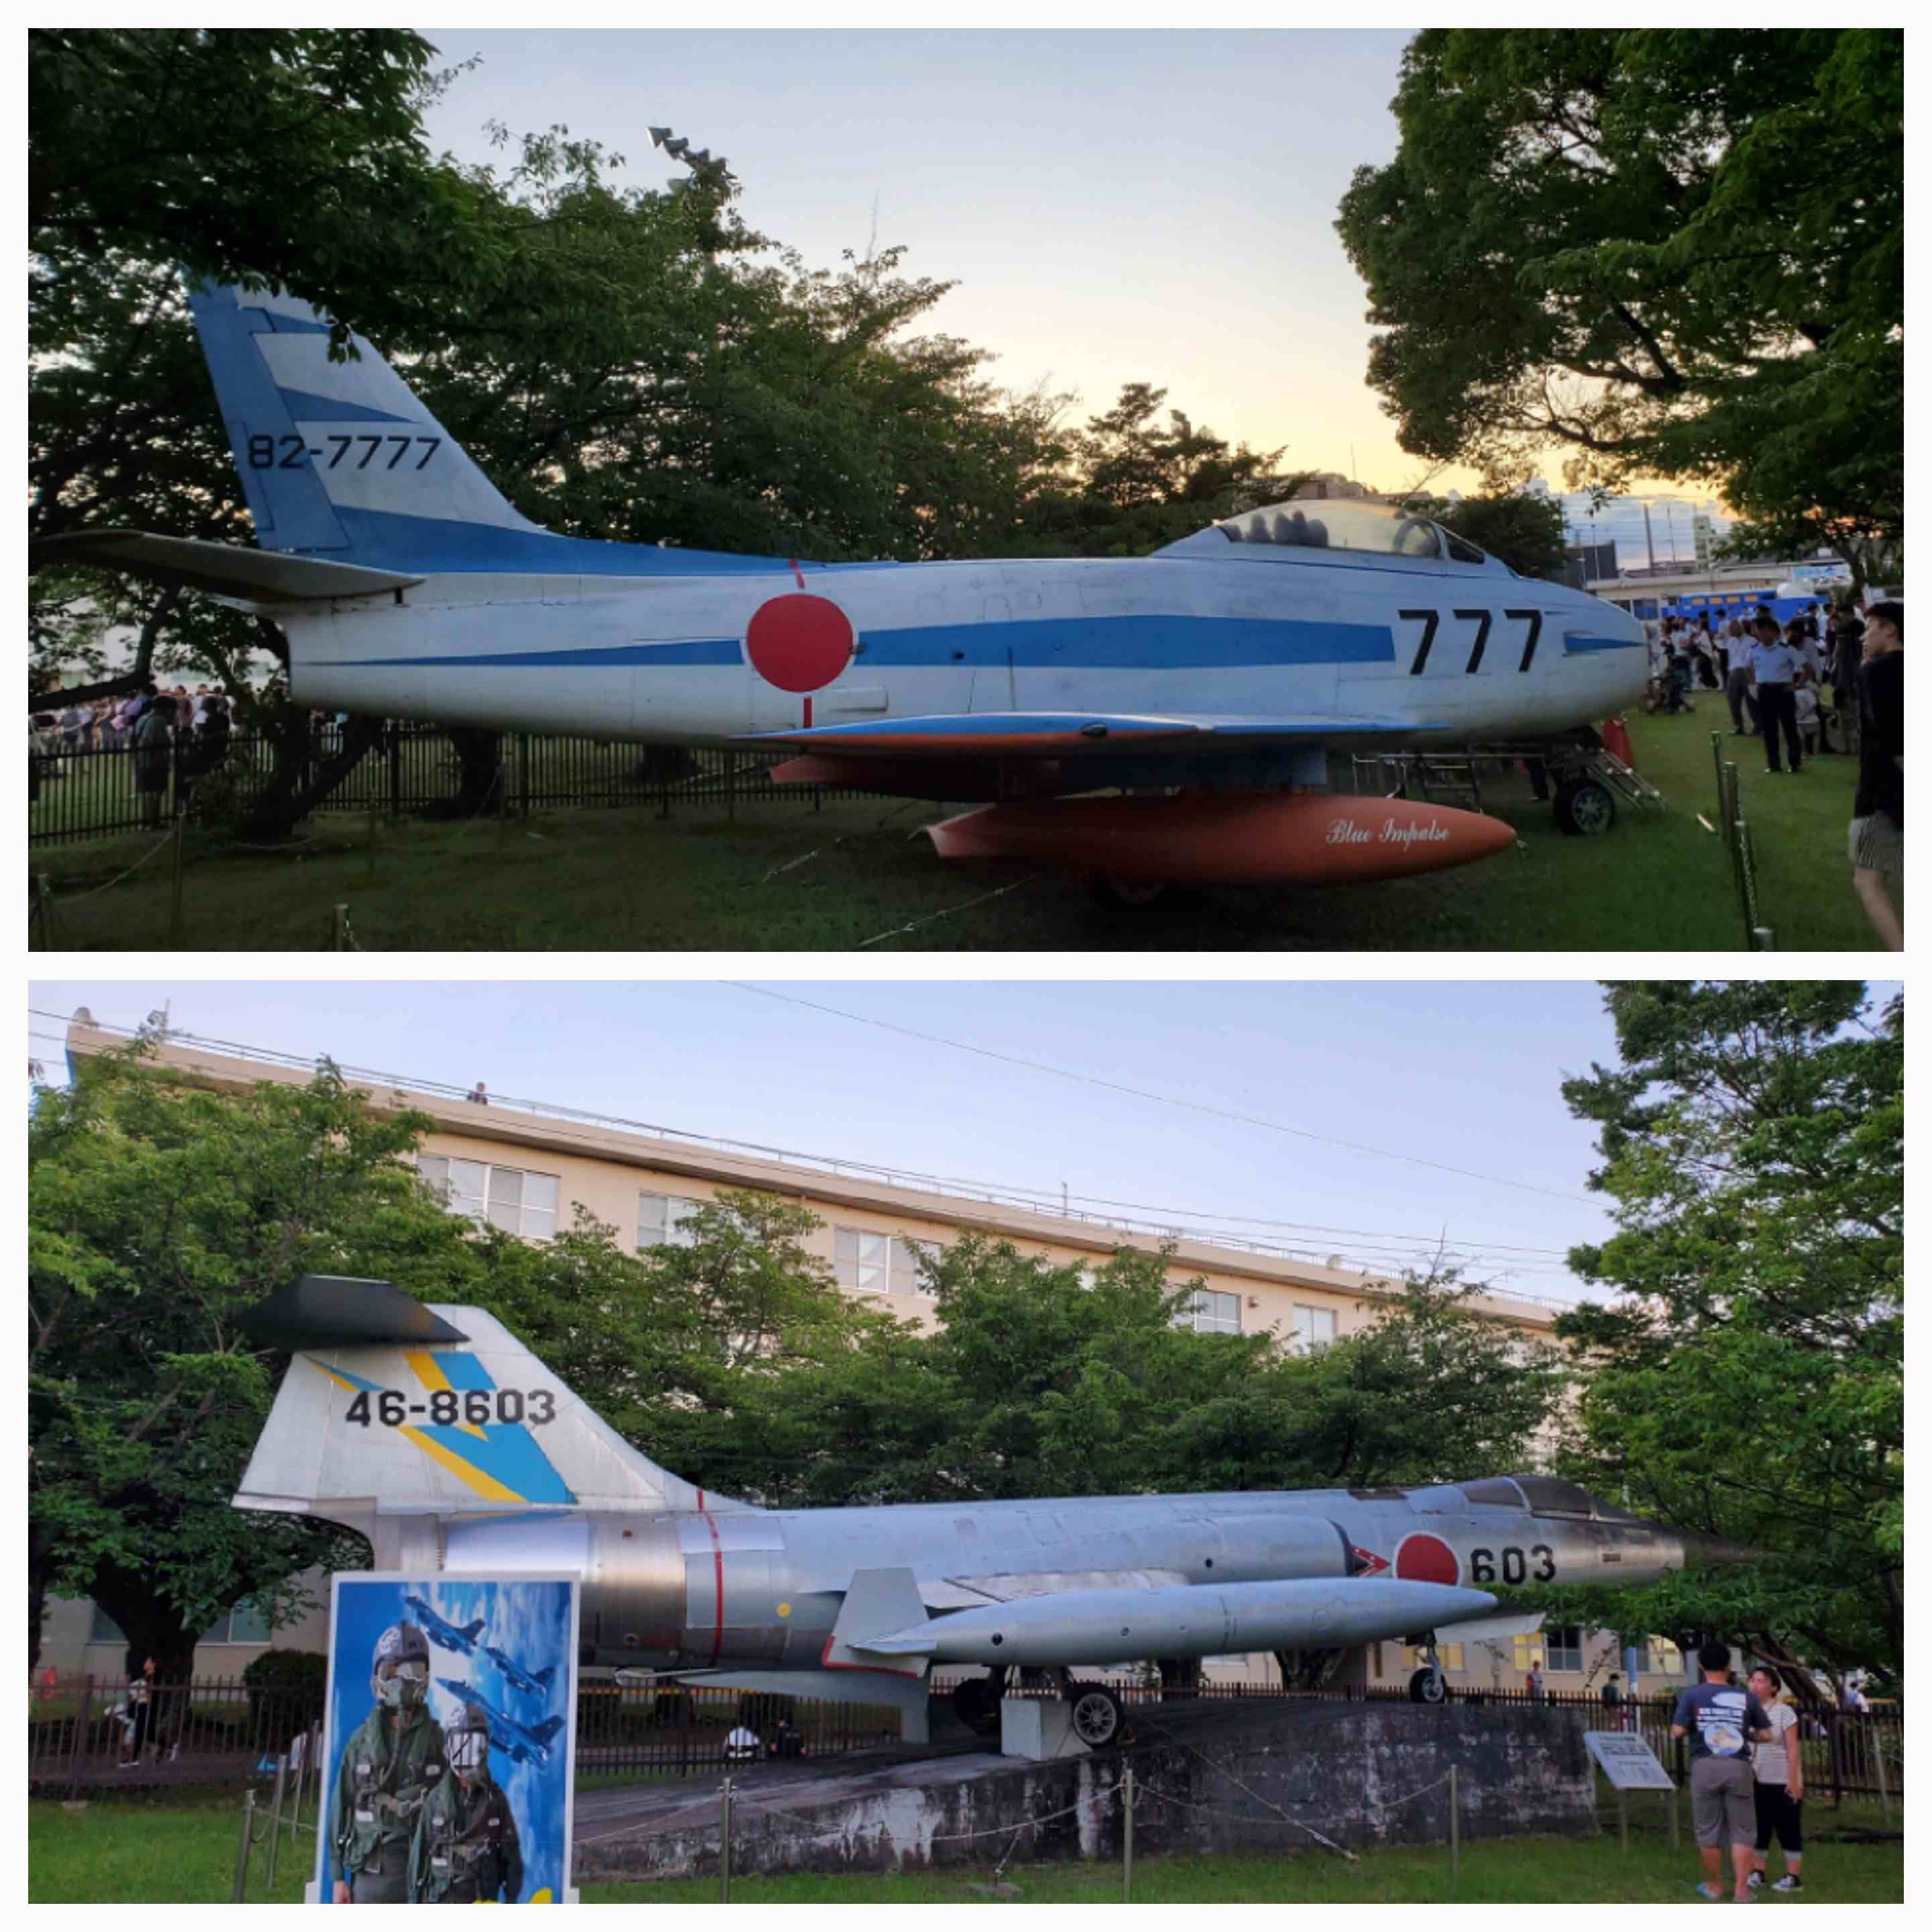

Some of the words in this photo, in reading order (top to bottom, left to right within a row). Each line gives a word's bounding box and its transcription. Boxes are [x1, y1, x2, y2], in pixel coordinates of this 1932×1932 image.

[248, 435, 441, 470] 82-7777
[1397, 608, 1542, 676] 777
[1326, 818, 1371, 844] Blue
[1379, 817, 1450, 852] Impulse
[345, 1389, 555, 1427] 46-8603
[1470, 1544, 1556, 1585] 603
